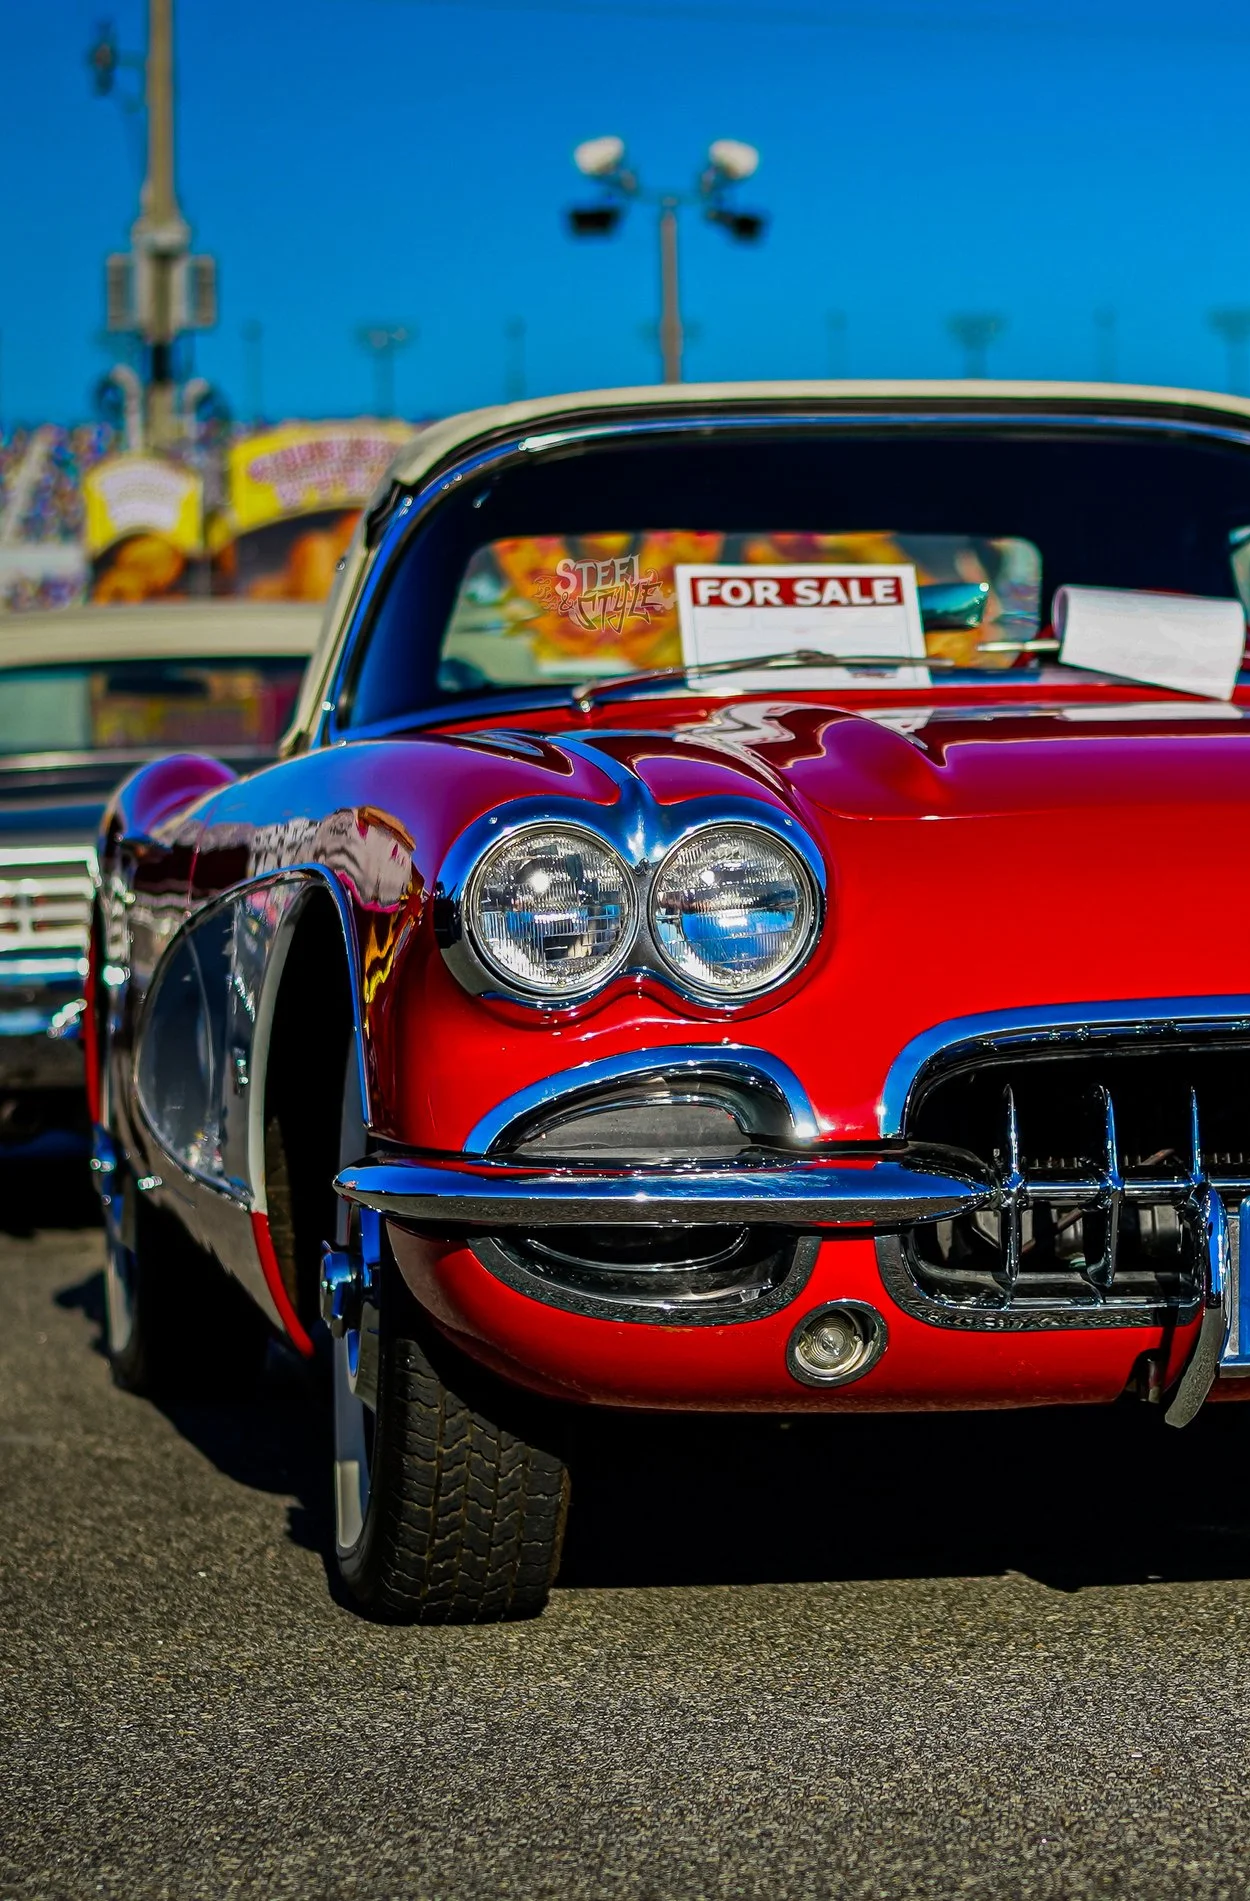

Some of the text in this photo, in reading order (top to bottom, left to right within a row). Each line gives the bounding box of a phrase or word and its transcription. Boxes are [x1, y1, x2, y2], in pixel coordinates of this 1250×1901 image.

[555, 554, 641, 596] STEEL
[697, 579, 897, 606] FOR SALE
[560, 580, 662, 634] & STYLE
